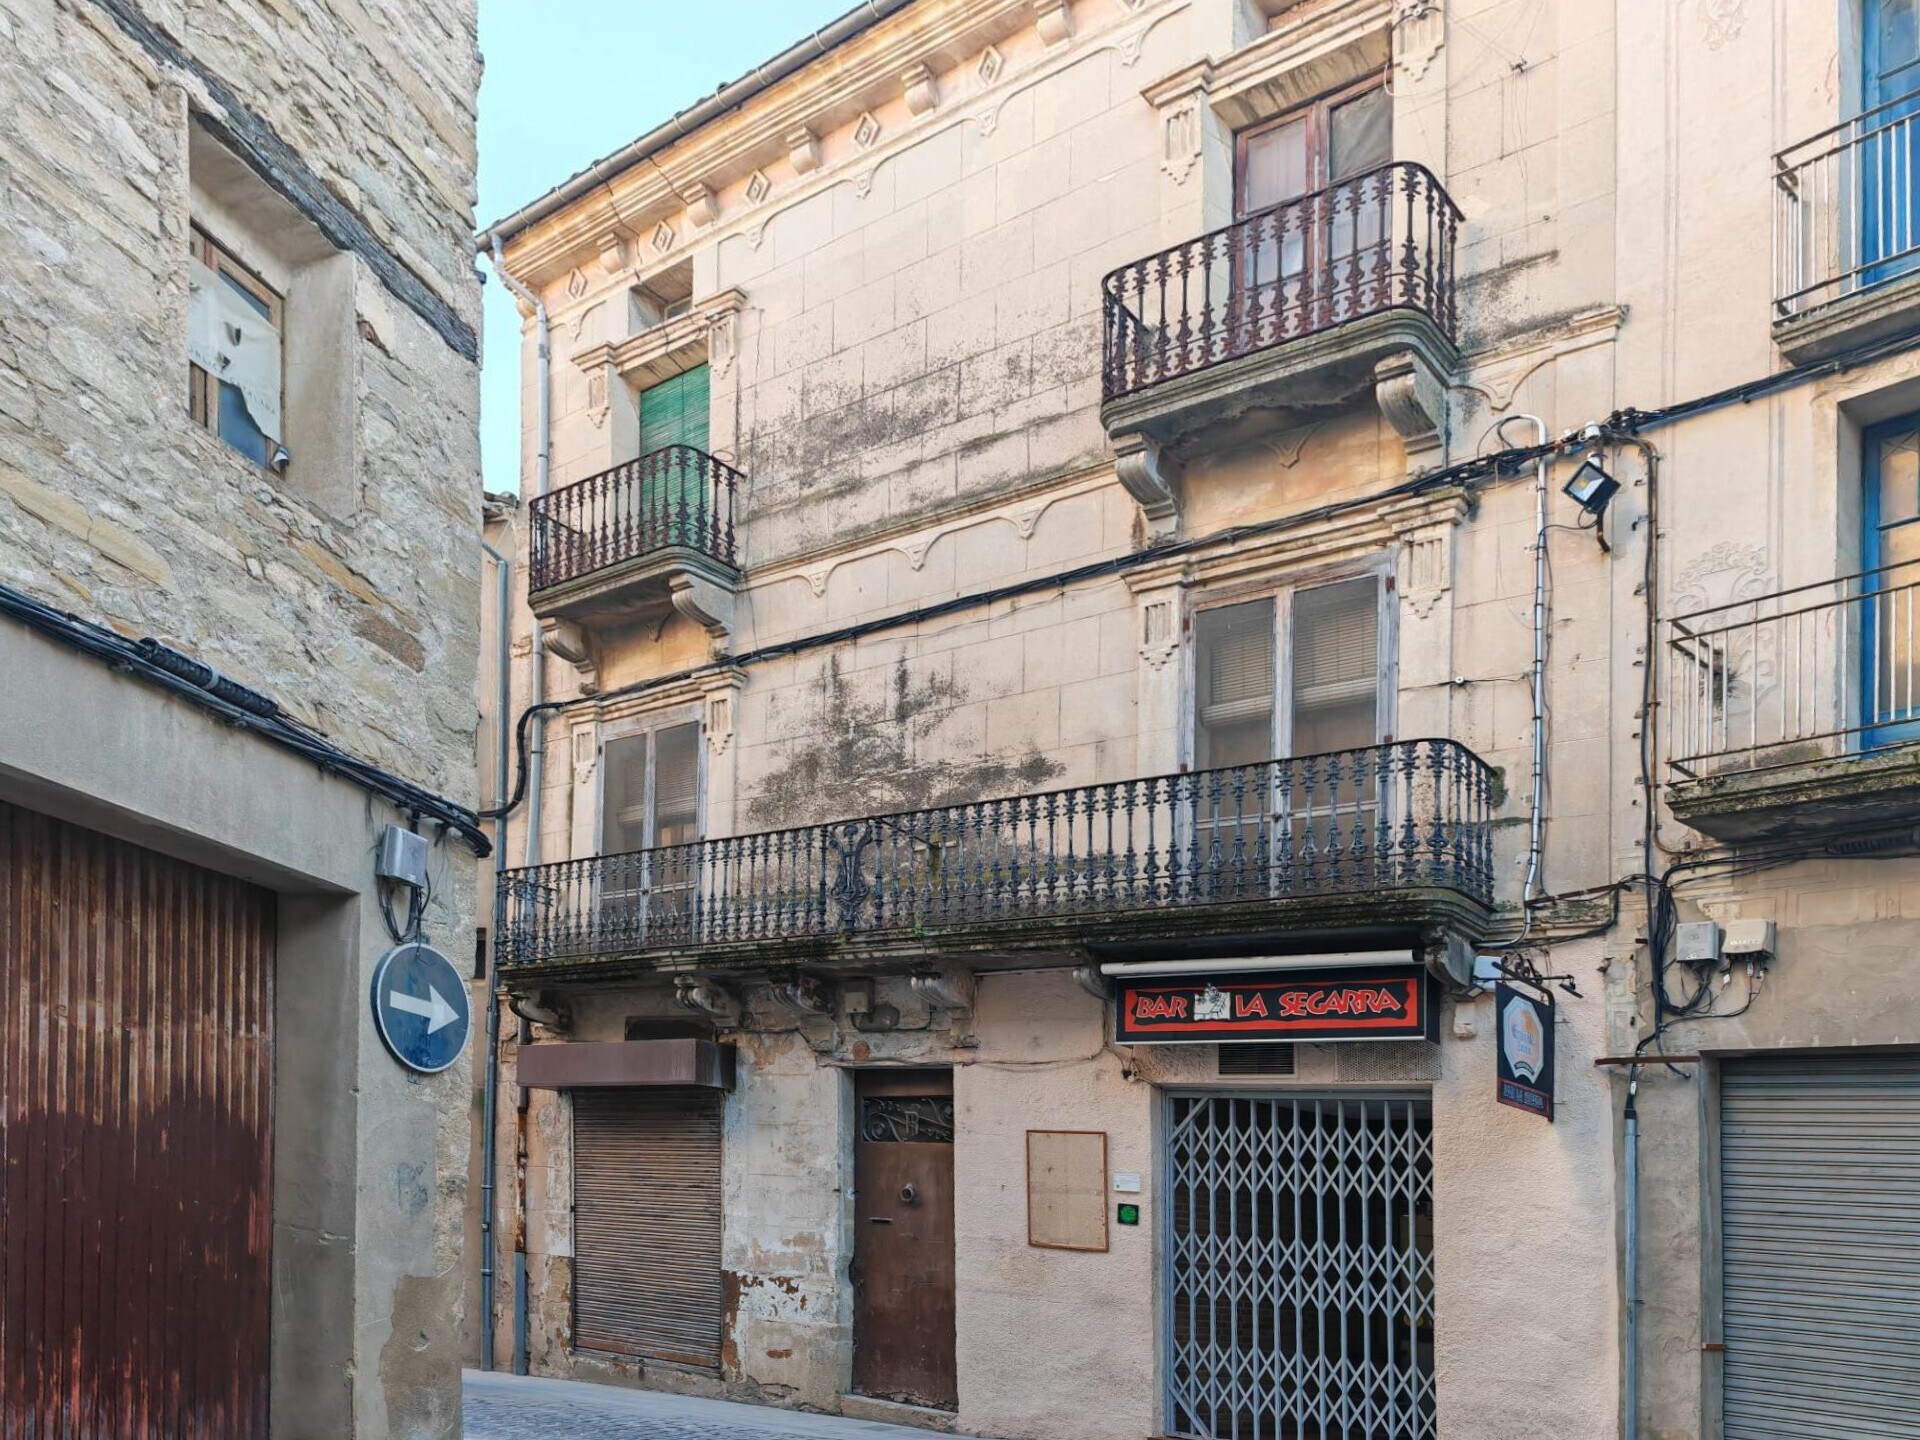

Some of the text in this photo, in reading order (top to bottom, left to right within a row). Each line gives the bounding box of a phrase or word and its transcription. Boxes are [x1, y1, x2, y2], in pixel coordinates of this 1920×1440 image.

[1136, 987, 1402, 1019] BAR LA SEGARRA
